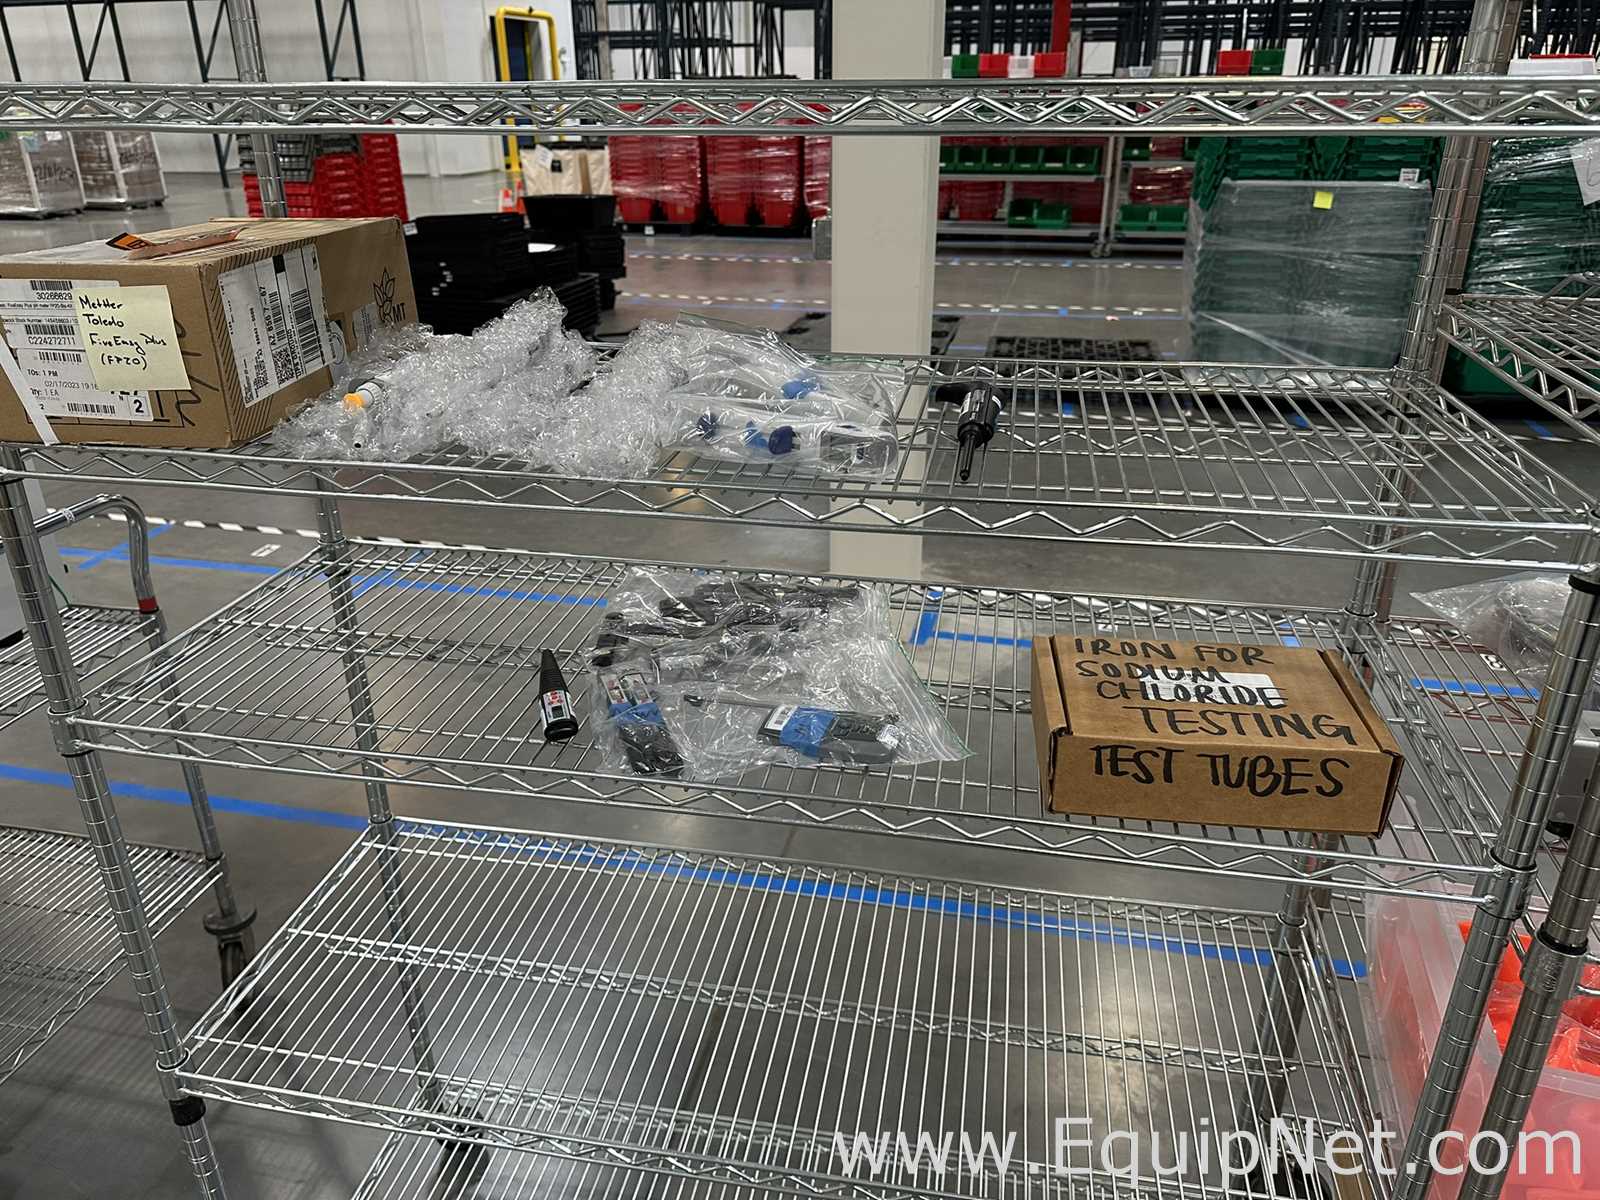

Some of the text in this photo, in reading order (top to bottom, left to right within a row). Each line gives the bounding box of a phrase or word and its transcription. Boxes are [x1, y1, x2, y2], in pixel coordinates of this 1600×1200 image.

[82, 313, 125, 328] Toledo
[133, 399, 145, 413] 2
[1075, 637, 1274, 666] IRON FOR
[1074, 660, 1230, 684] SODIUM
[1097, 680, 1289, 709] CHLORIDE
[1123, 705, 1358, 746] TESTING
[1090, 744, 1351, 798] TEST TUBES
